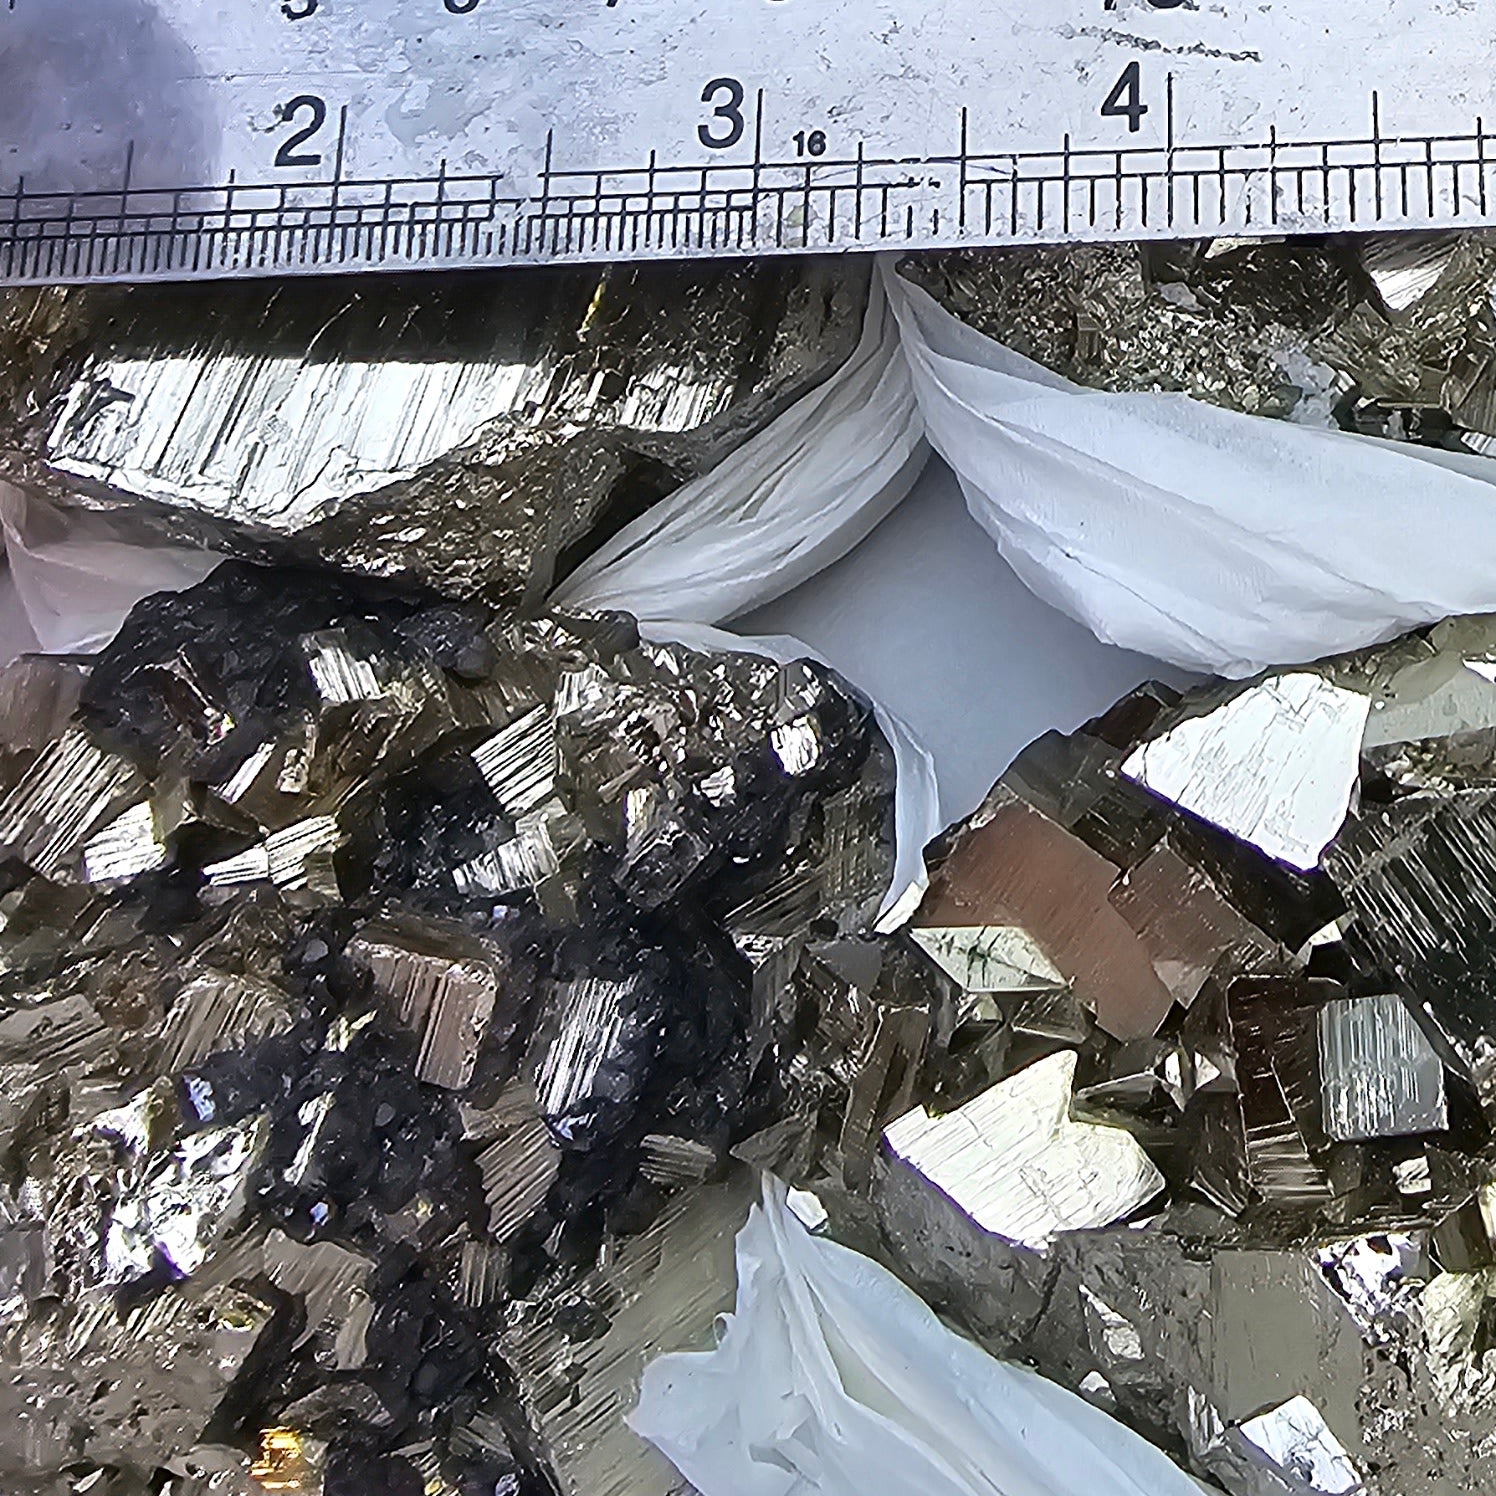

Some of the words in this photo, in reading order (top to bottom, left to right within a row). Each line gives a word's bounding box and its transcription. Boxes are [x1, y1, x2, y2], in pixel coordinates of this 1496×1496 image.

[274, 95, 326, 166] 2
[698, 77, 744, 148] 3
[1101, 61, 1147, 132] 4
[792, 130, 826, 156] 16
